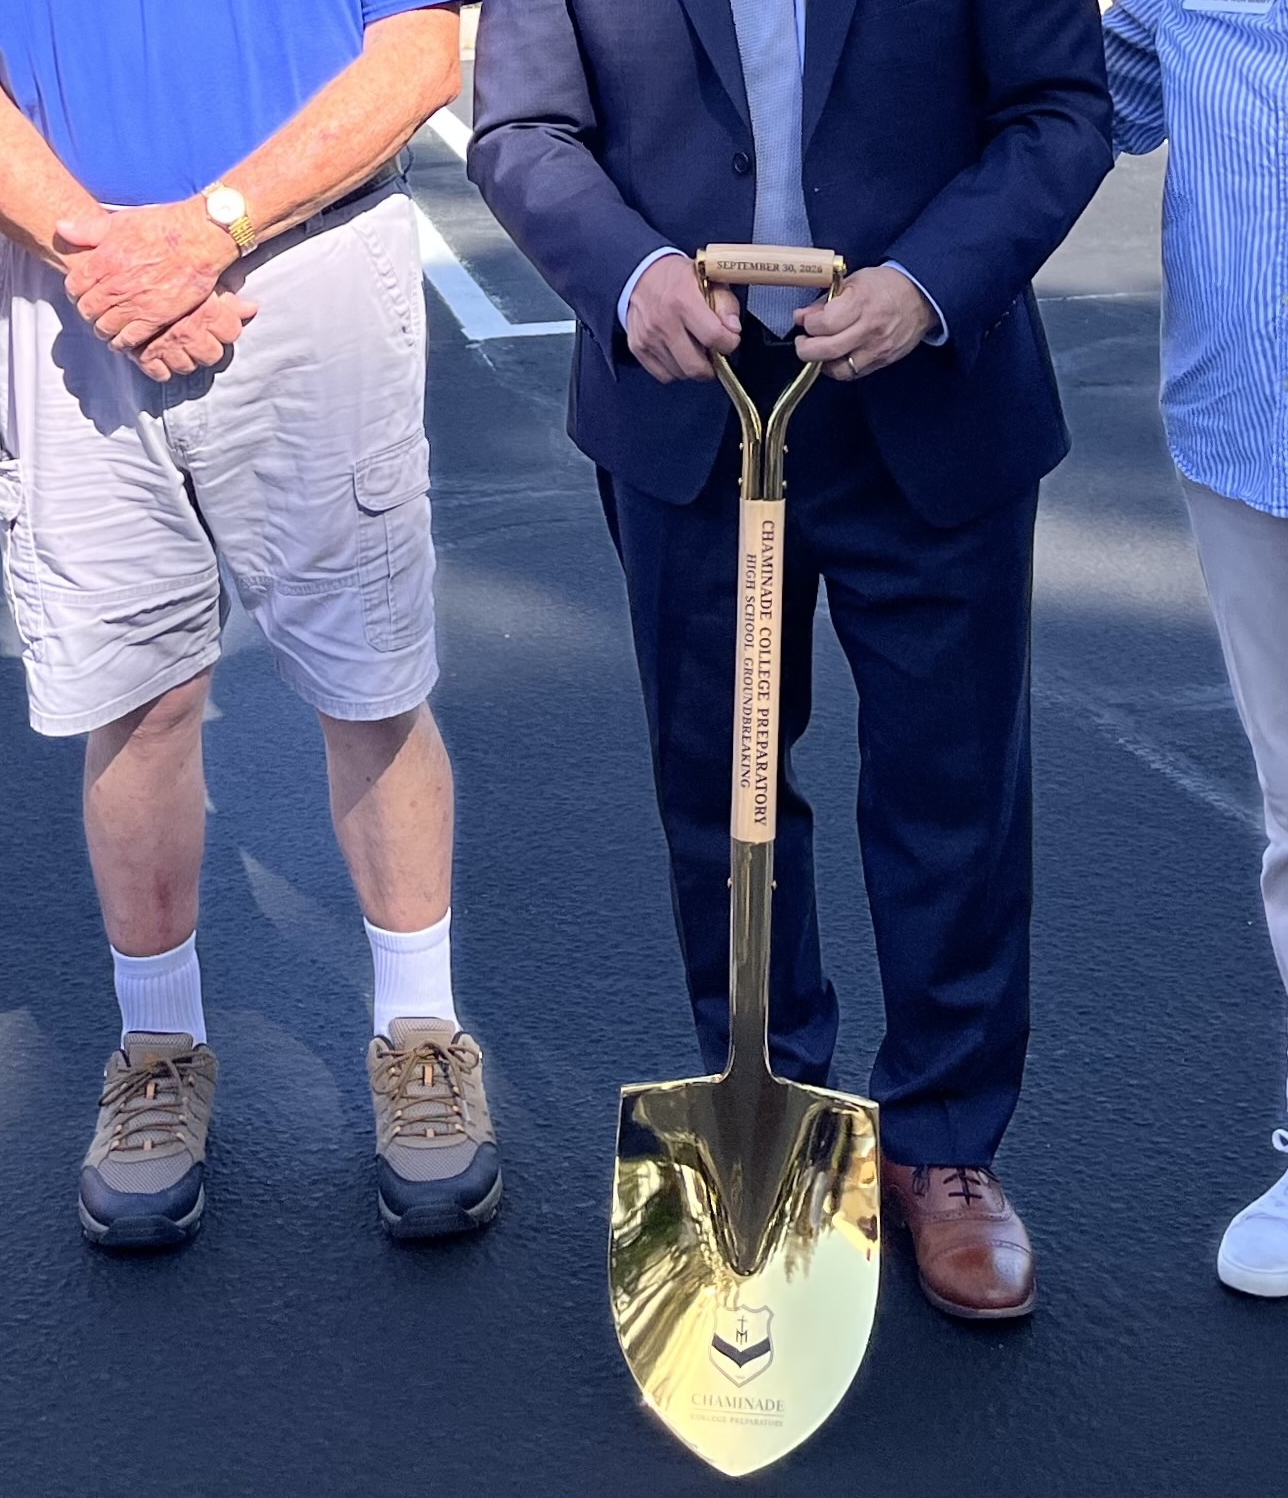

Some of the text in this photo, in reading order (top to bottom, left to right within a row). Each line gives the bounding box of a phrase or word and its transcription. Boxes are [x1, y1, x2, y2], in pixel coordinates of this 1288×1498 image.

[716, 260, 780, 273] SEPTEMBER
[782, 263, 797, 275] 30,
[740, 553, 757, 789] HIGH SCHOOL GROUNDBREAKING
[754, 520, 775, 826] CHAMINADE COLLEGE PREPARATORY
[690, 1393, 785, 1412] CHAMINADE
[690, 1413, 784, 1427] COLLEGE PREPARATORY
